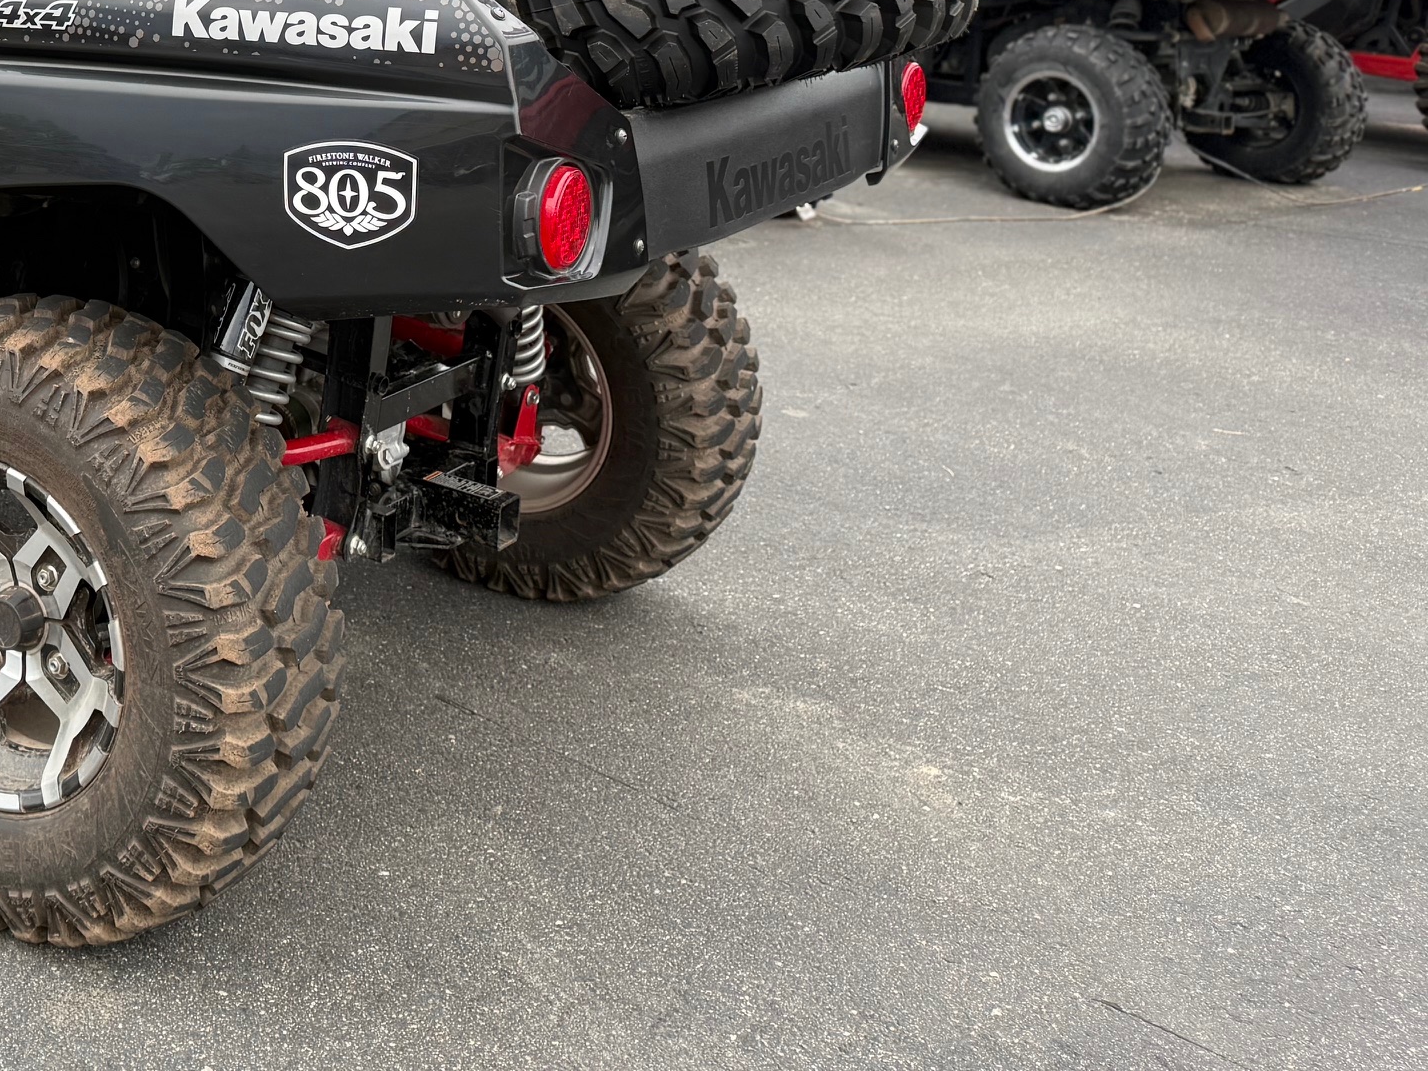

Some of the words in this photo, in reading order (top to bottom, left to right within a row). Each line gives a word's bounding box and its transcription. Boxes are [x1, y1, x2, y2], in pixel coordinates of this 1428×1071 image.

[308, 152, 354, 164] FIRESTONE
[357, 153, 391, 168] WALKER
[705, 115, 853, 229] Kawasaki
[293, 167, 406, 220] 805
[237, 288, 272, 359] FOX
